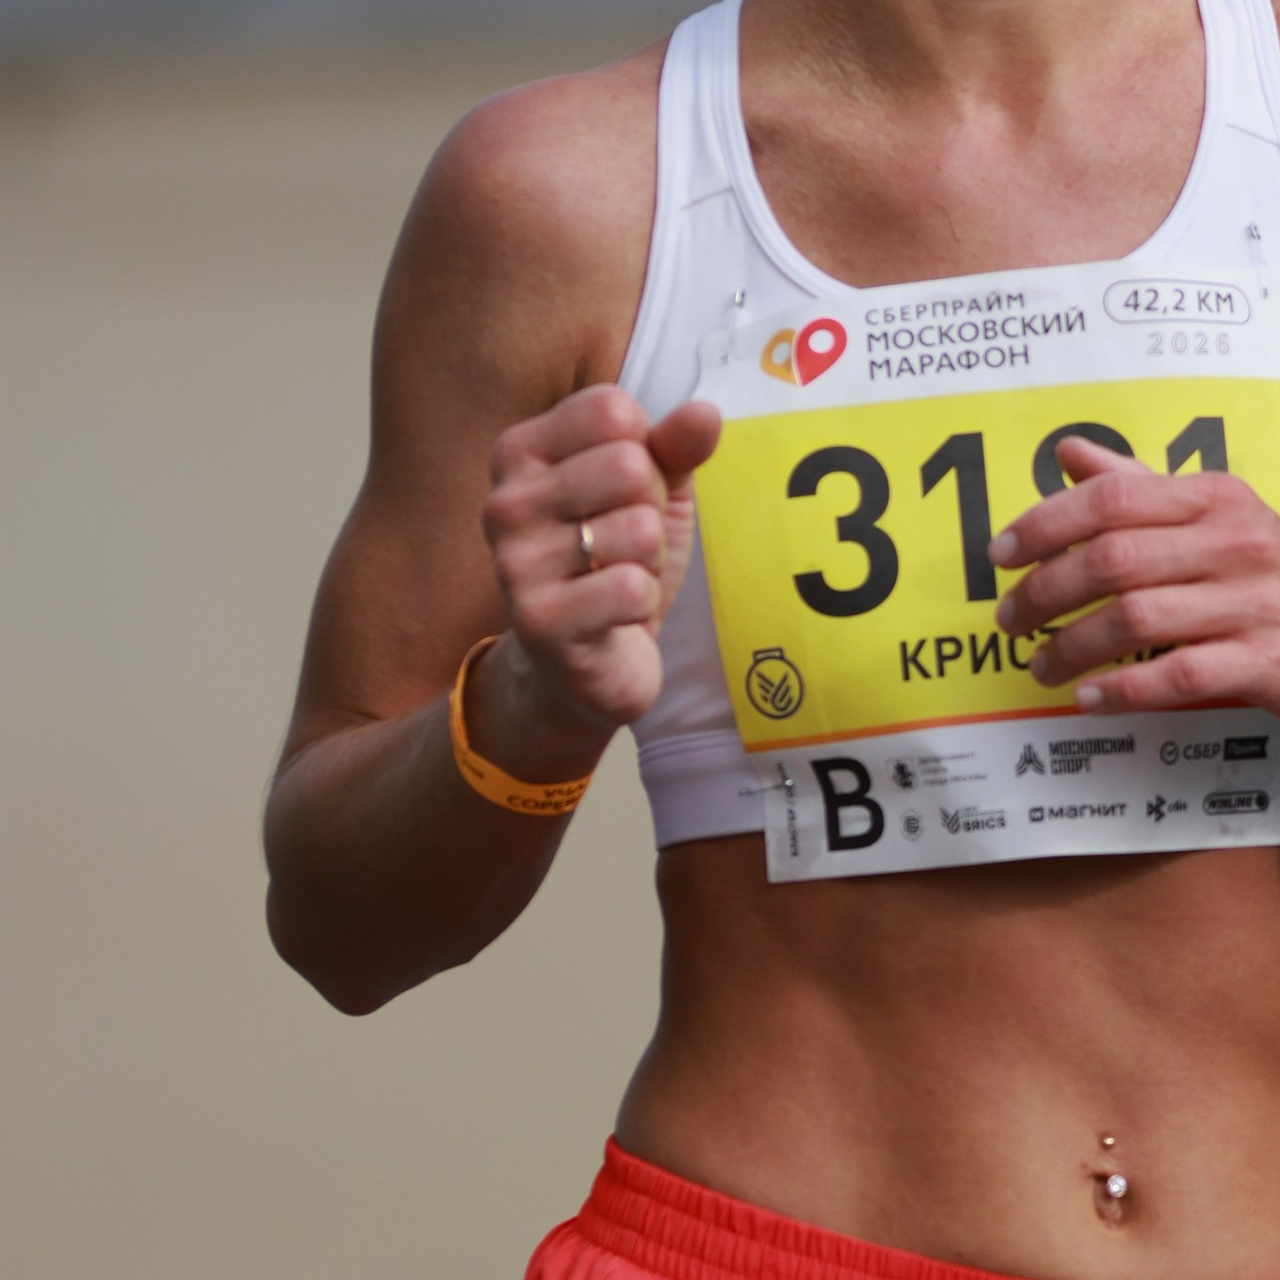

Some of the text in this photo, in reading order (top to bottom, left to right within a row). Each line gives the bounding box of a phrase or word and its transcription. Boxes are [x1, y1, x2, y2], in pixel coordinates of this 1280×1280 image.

[865, 291, 1026, 326] СБЕРПРАЙМ
[1123, 287, 1235, 314] 42,2 КМ
[866, 307, 1087, 352] МОСКОВСКИЙ
[1147, 330, 1230, 356] 2026
[868, 345, 1030, 380] МАРАФОН
[1048, 732, 1136, 757] МОСКОВСКИЙ
[1183, 742, 1222, 761] СБЕР
[1050, 757, 1092, 776] СПОРТ
[963, 817, 1006, 834] BRICS
